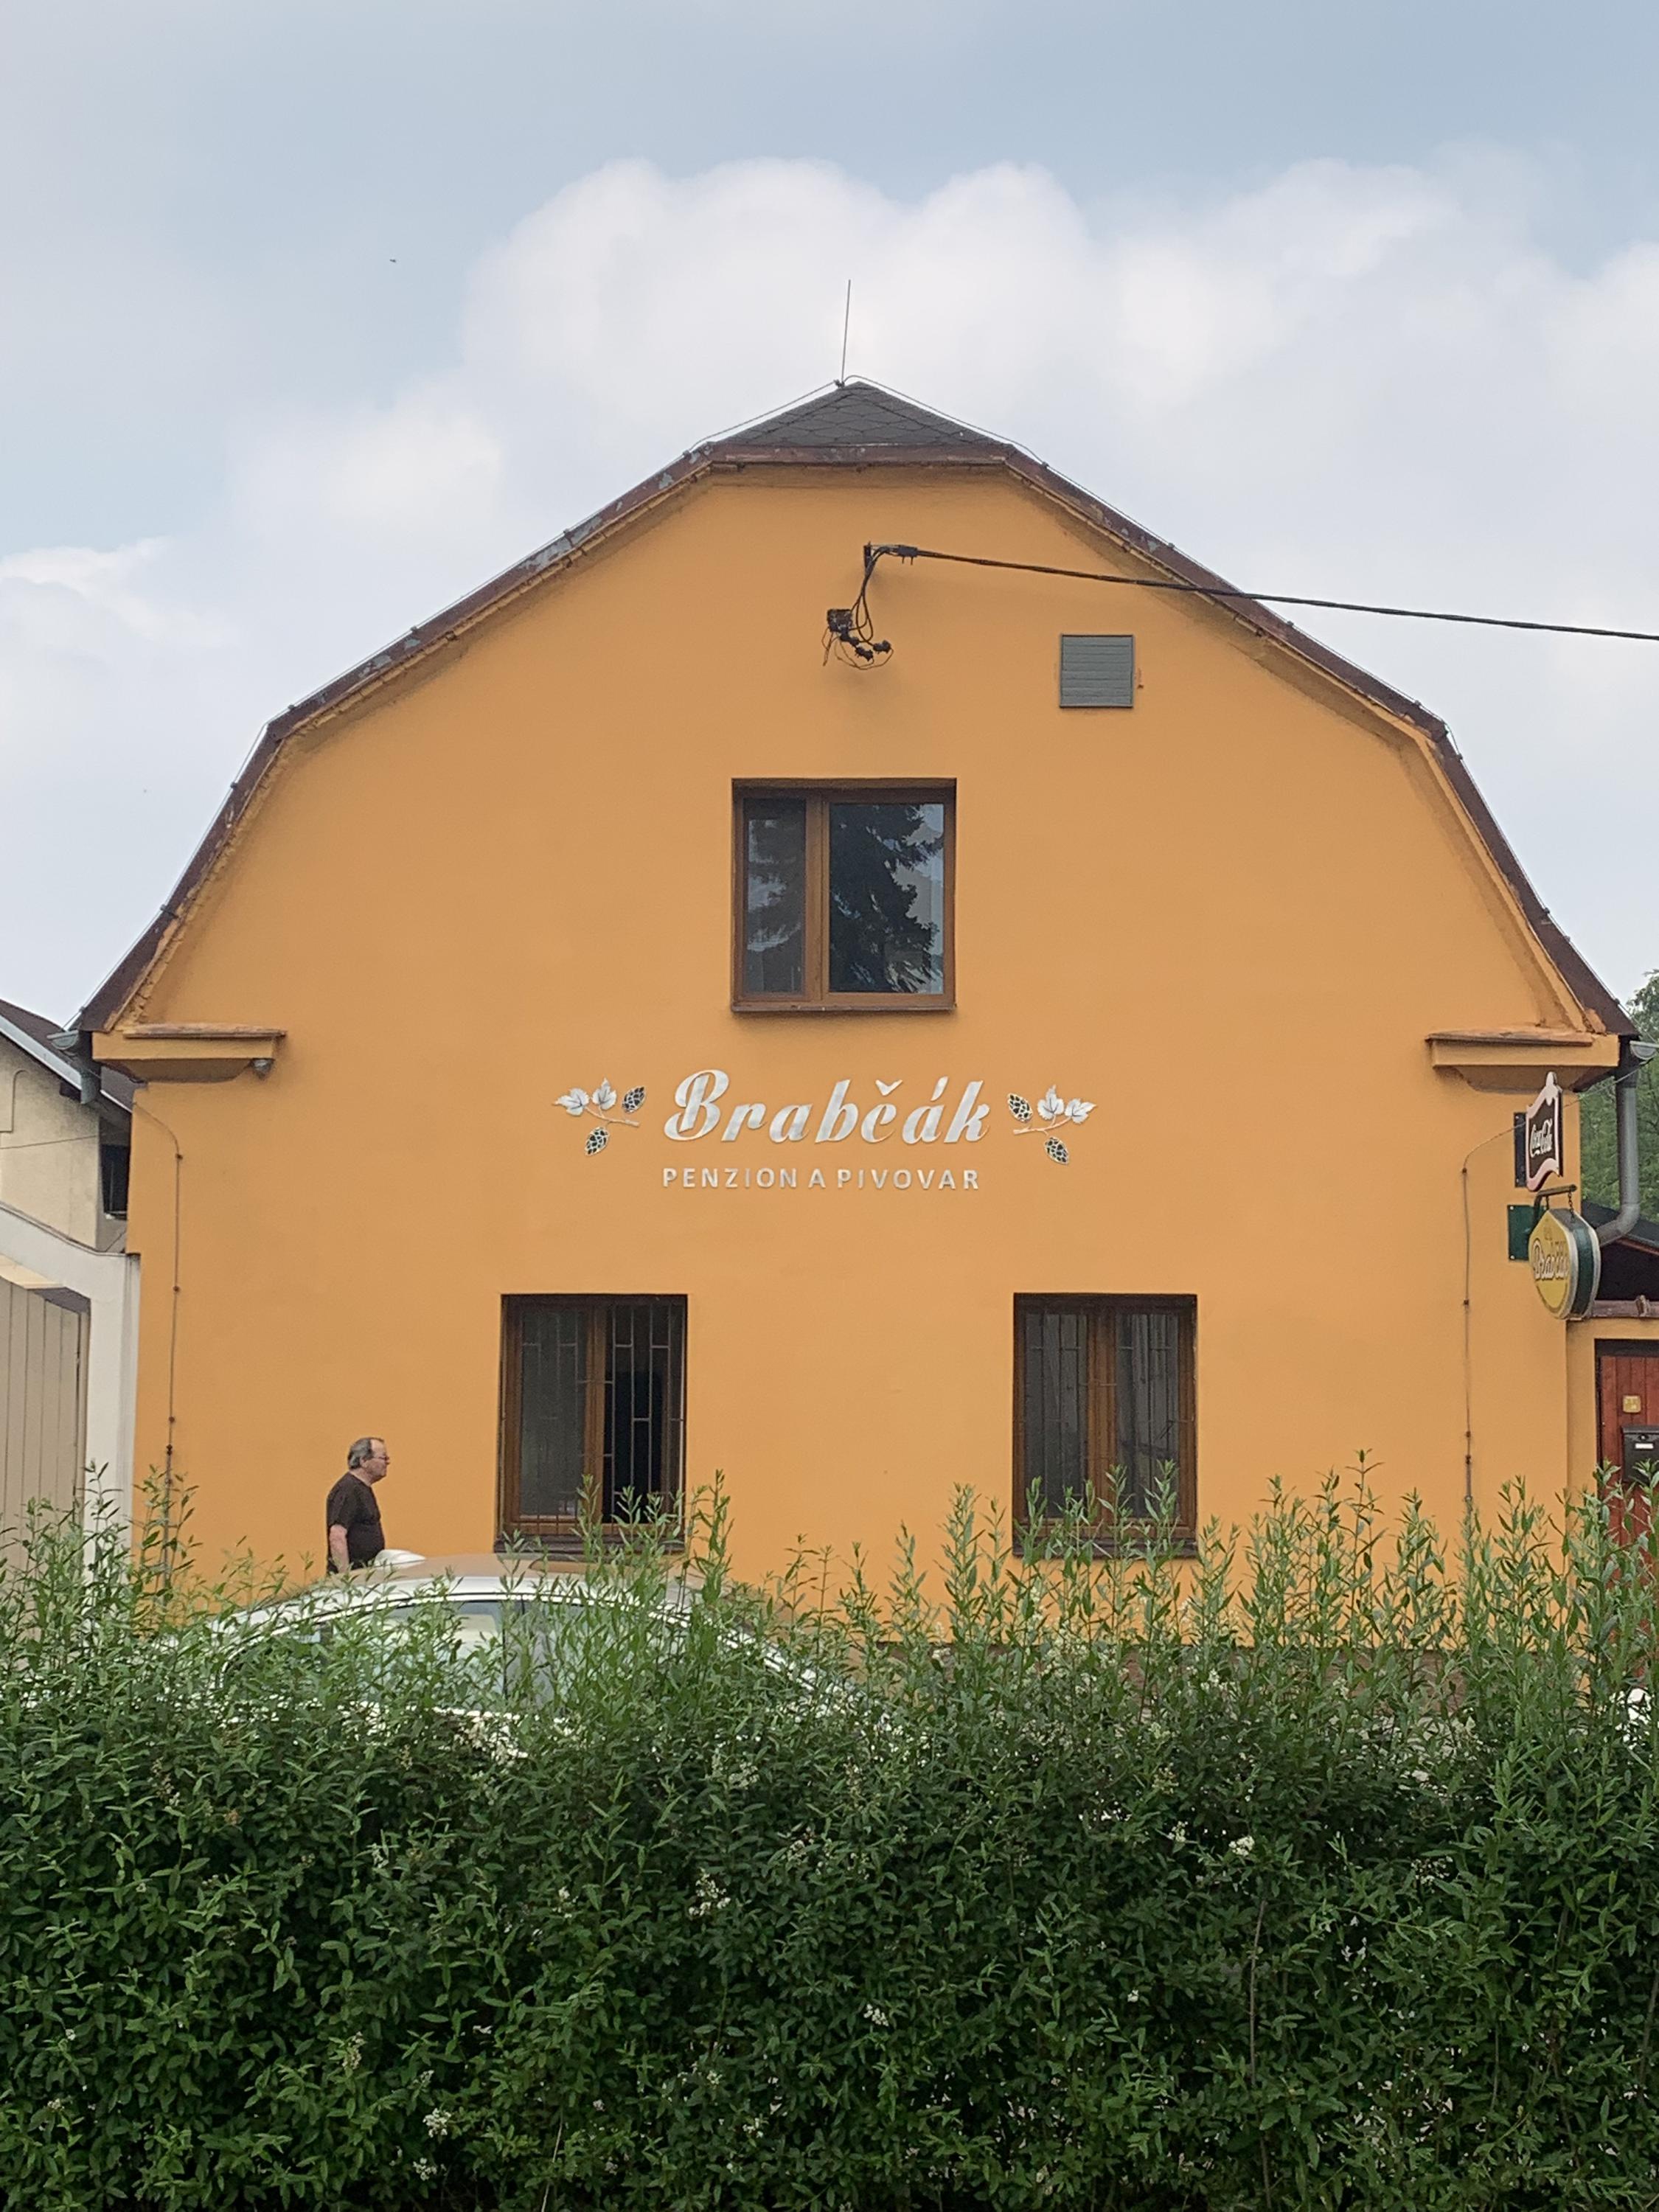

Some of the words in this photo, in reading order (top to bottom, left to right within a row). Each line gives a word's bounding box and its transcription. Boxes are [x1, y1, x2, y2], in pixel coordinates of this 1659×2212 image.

[664, 1068, 990, 1144] Brabčák
[663, 1167, 797, 1189] PENZION
[807, 1167, 827, 1189] A
[837, 1168, 979, 1190] PIVOVAR
